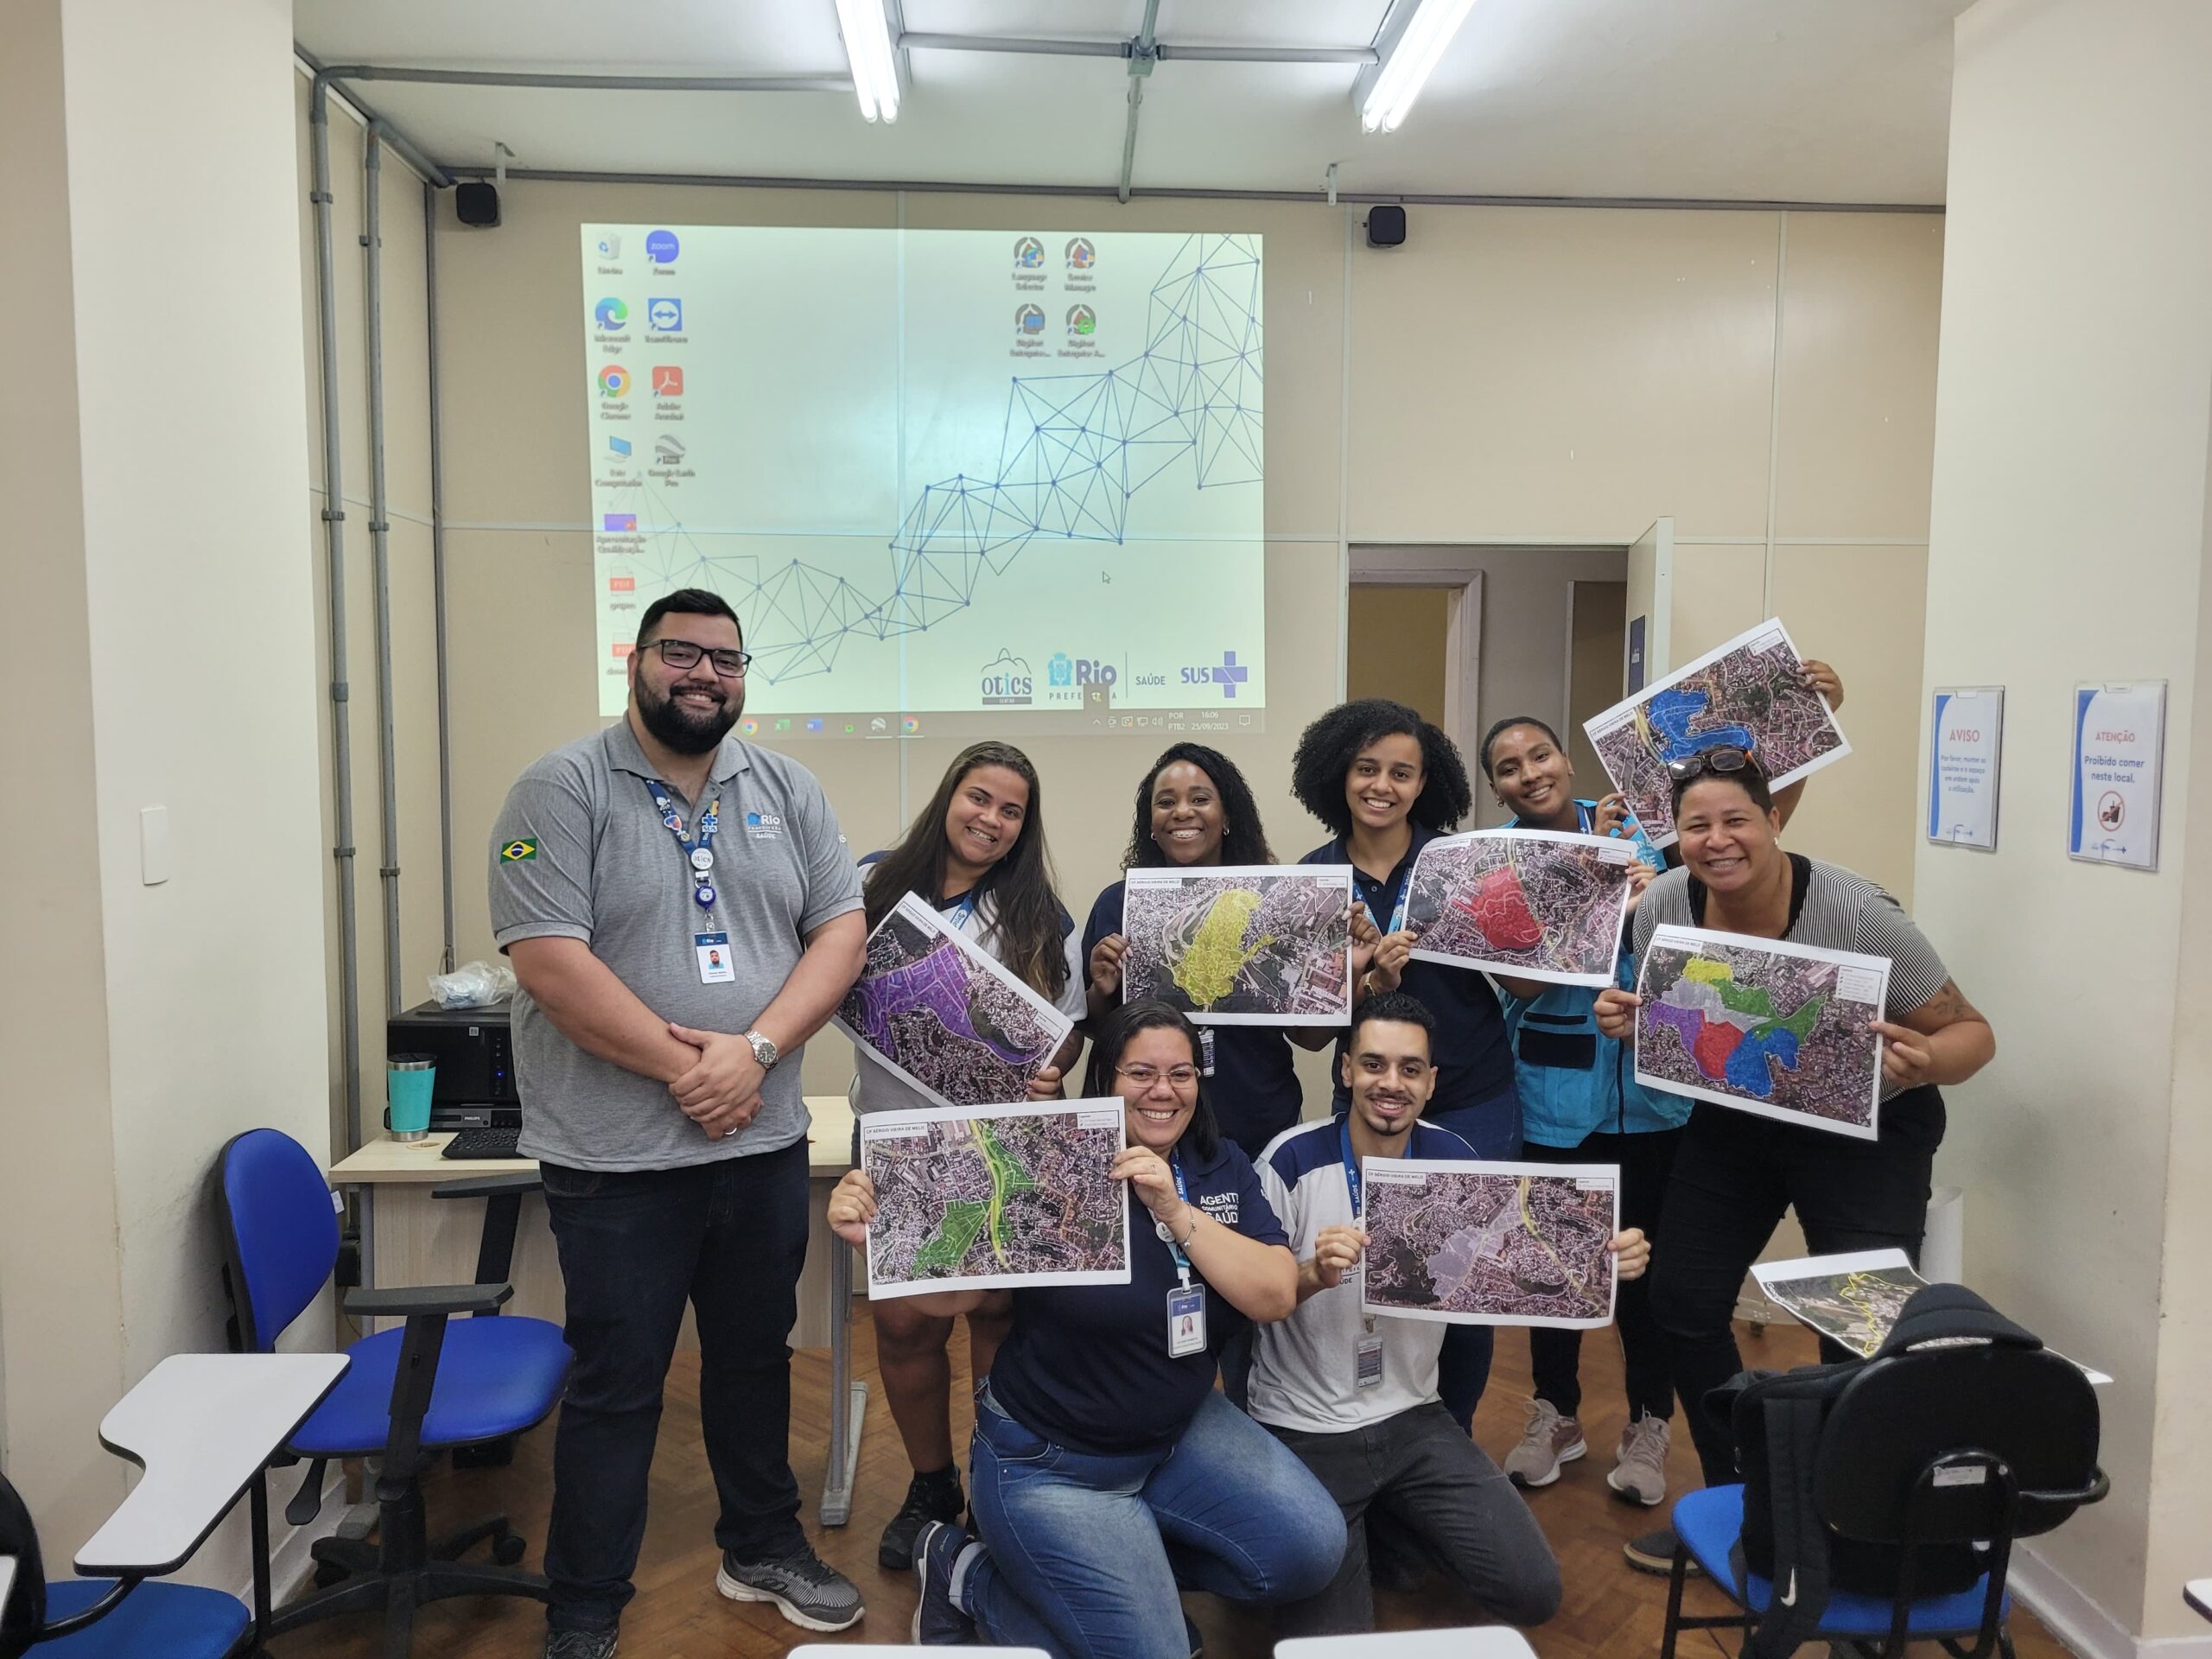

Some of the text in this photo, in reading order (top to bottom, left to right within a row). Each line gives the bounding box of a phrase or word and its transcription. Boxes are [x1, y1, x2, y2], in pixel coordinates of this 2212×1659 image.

[613, 580, 631, 588] PDF
[1076, 659, 1117, 686] Rio
[1135, 672, 1166, 685] SAÚDE
[1180, 667, 1210, 683] SUS
[982, 672, 1033, 696] otics
[1192, 722, 1229, 731] 25/09/2023
[1948, 729, 1980, 742] AVISO
[2095, 729, 2135, 745] ATENÇÃO
[2084, 755, 2145, 768] Proibido comer
[2091, 772, 2112, 781] neste
[761, 815, 780, 825] Rio
[1351, 1184, 1360, 1204] SAÚDE
